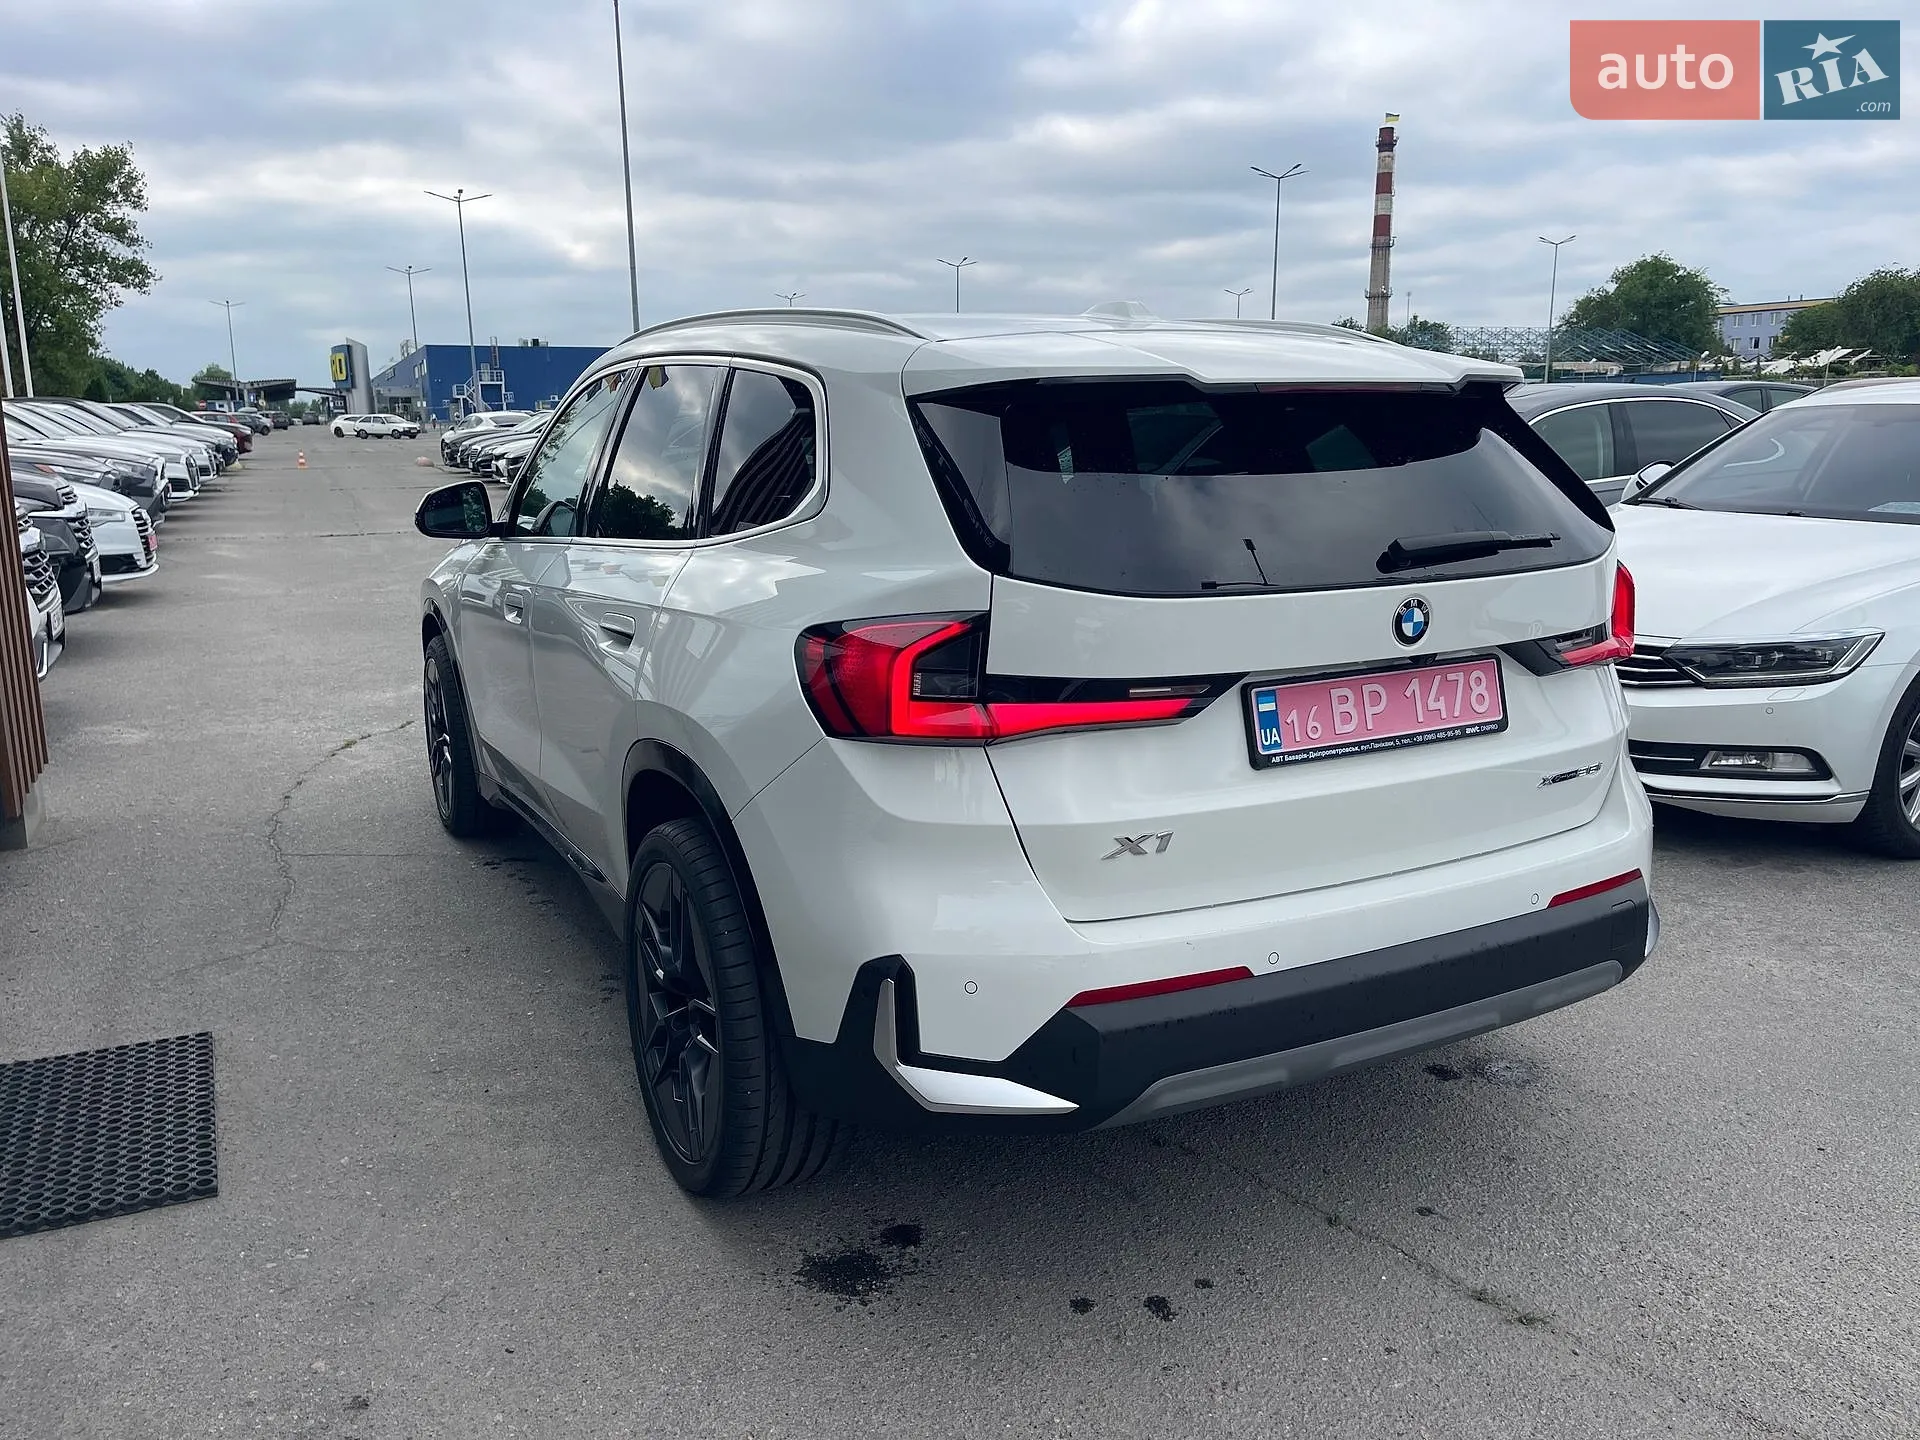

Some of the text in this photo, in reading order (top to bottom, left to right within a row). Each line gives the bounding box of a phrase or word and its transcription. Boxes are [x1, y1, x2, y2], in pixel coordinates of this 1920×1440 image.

[1399, 599, 1429, 615] BMW
[1285, 704, 1322, 743] 16
[1404, 669, 1490, 723] 1478
[1260, 727, 1281, 746] UA
[1101, 831, 1174, 860] X1
